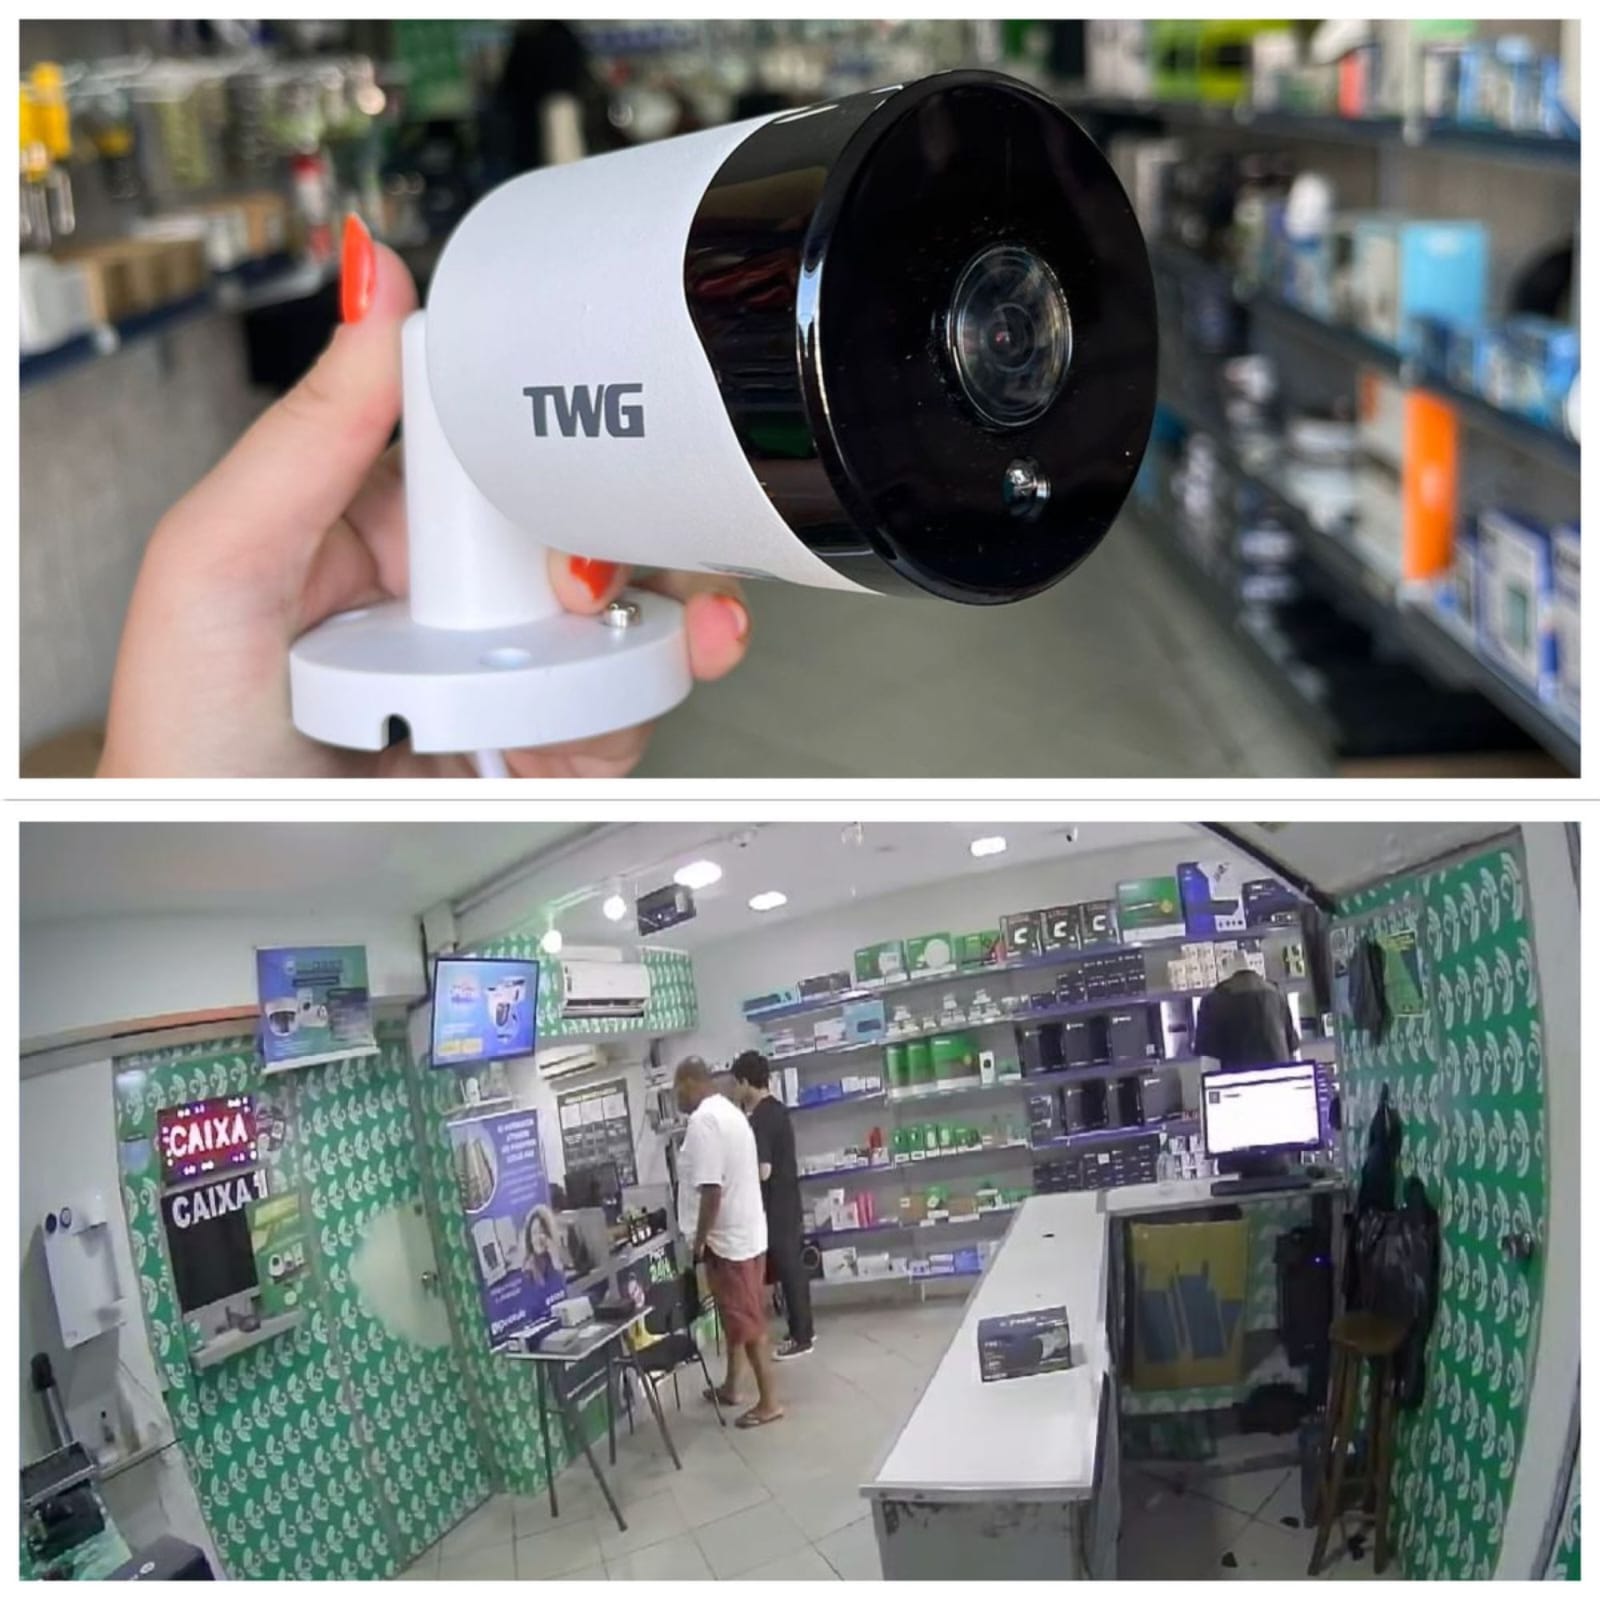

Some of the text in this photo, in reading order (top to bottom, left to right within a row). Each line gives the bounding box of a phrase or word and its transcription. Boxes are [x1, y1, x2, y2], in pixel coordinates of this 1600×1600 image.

[522, 383, 645, 438] TWG
[169, 1112, 249, 1157] CAIXA
[171, 1168, 268, 1229] CAIXA 1
